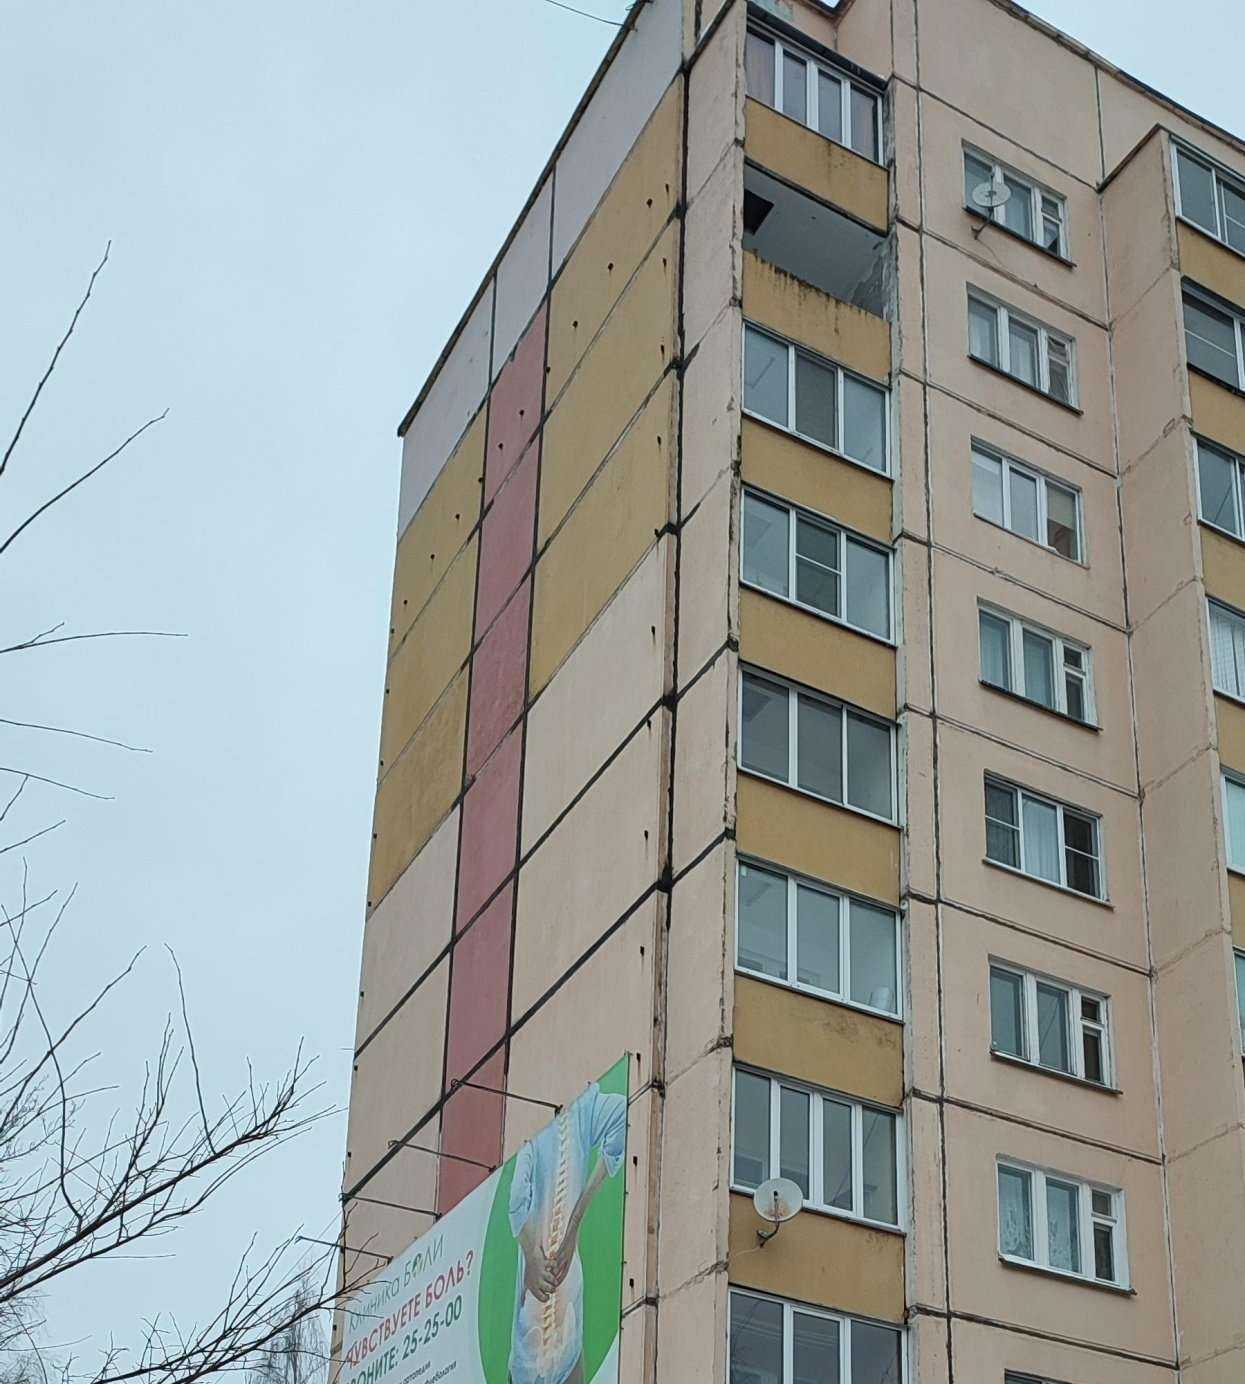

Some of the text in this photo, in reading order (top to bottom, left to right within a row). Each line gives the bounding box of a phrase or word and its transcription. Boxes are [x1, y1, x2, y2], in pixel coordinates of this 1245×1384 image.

[346, 1250, 474, 1367] ЧУВСТВУЕТЕ БОЛЬ?
[402, 1294, 462, 1360] 25-25-00
